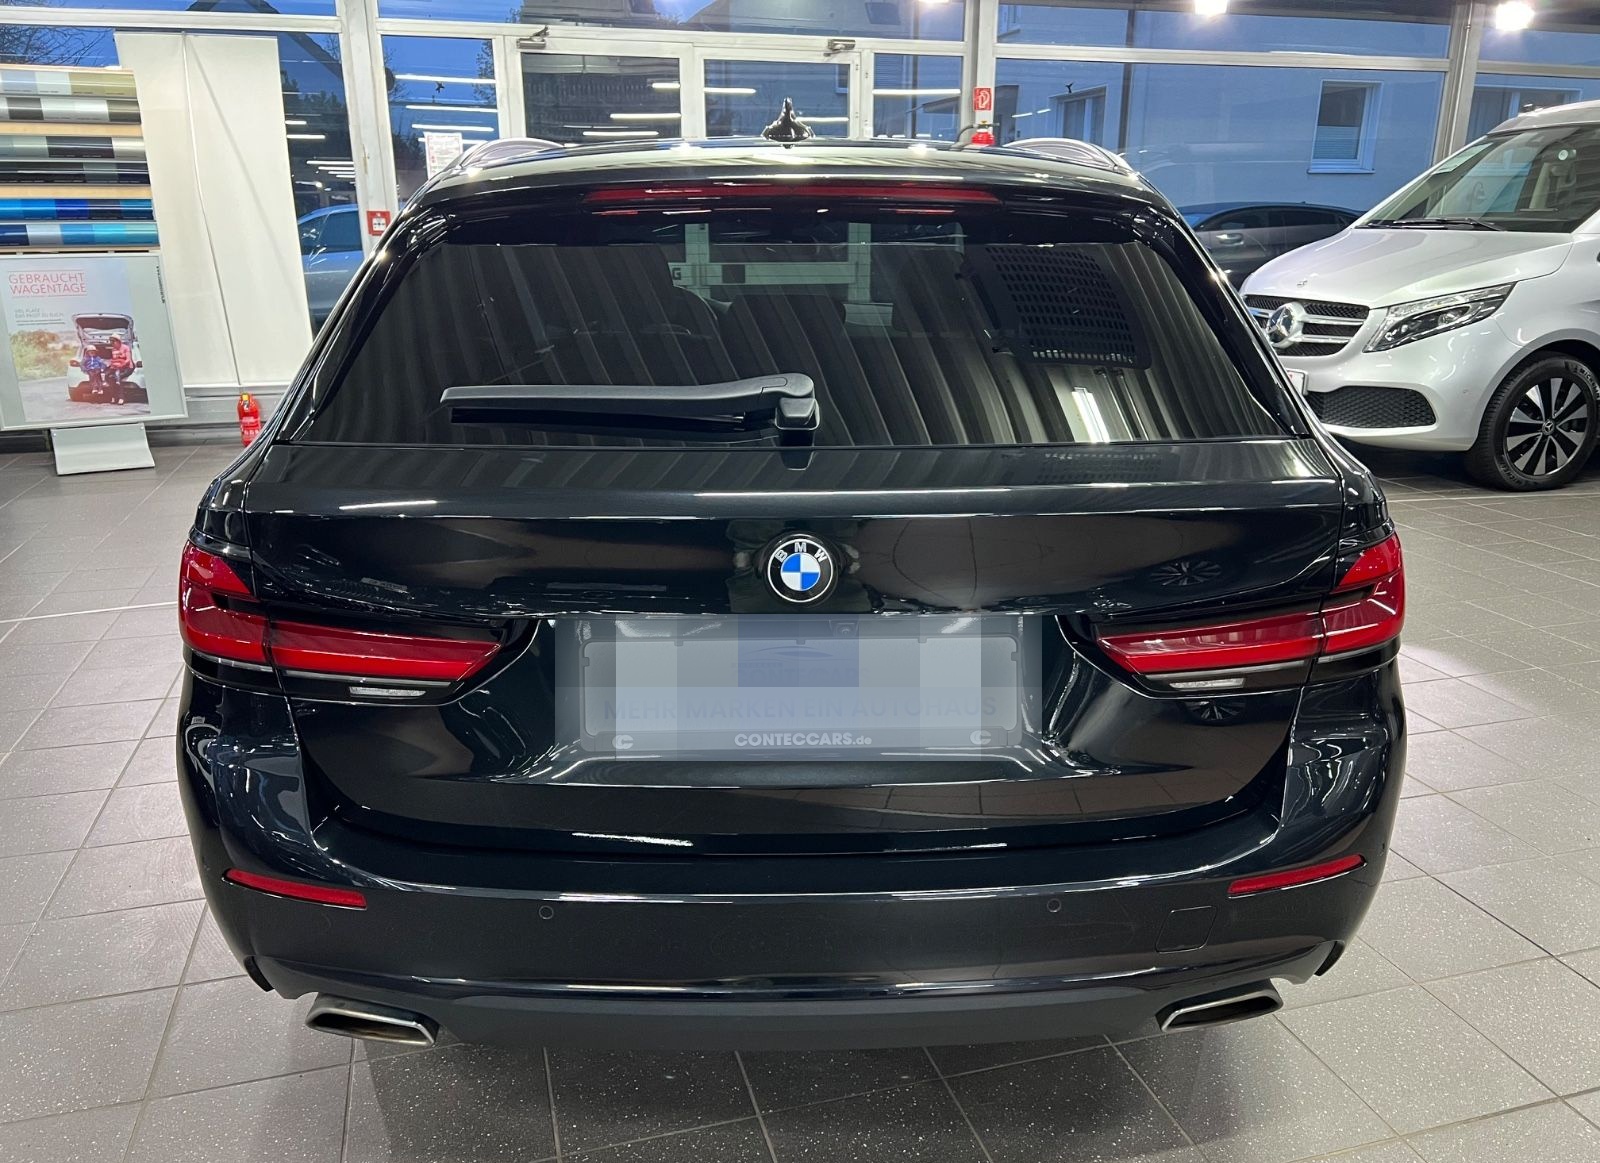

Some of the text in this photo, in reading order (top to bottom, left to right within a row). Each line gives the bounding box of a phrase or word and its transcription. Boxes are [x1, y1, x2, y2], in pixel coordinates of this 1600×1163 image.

[8, 272, 85, 284] GEBRAUCHT
[9, 283, 87, 294] WAGENTAGE
[774, 542, 828, 563] BMW
[603, 696, 997, 720] MEHR MARKEN EIN AUTOHAUS
[734, 732, 873, 747] CONTECCARS.de
